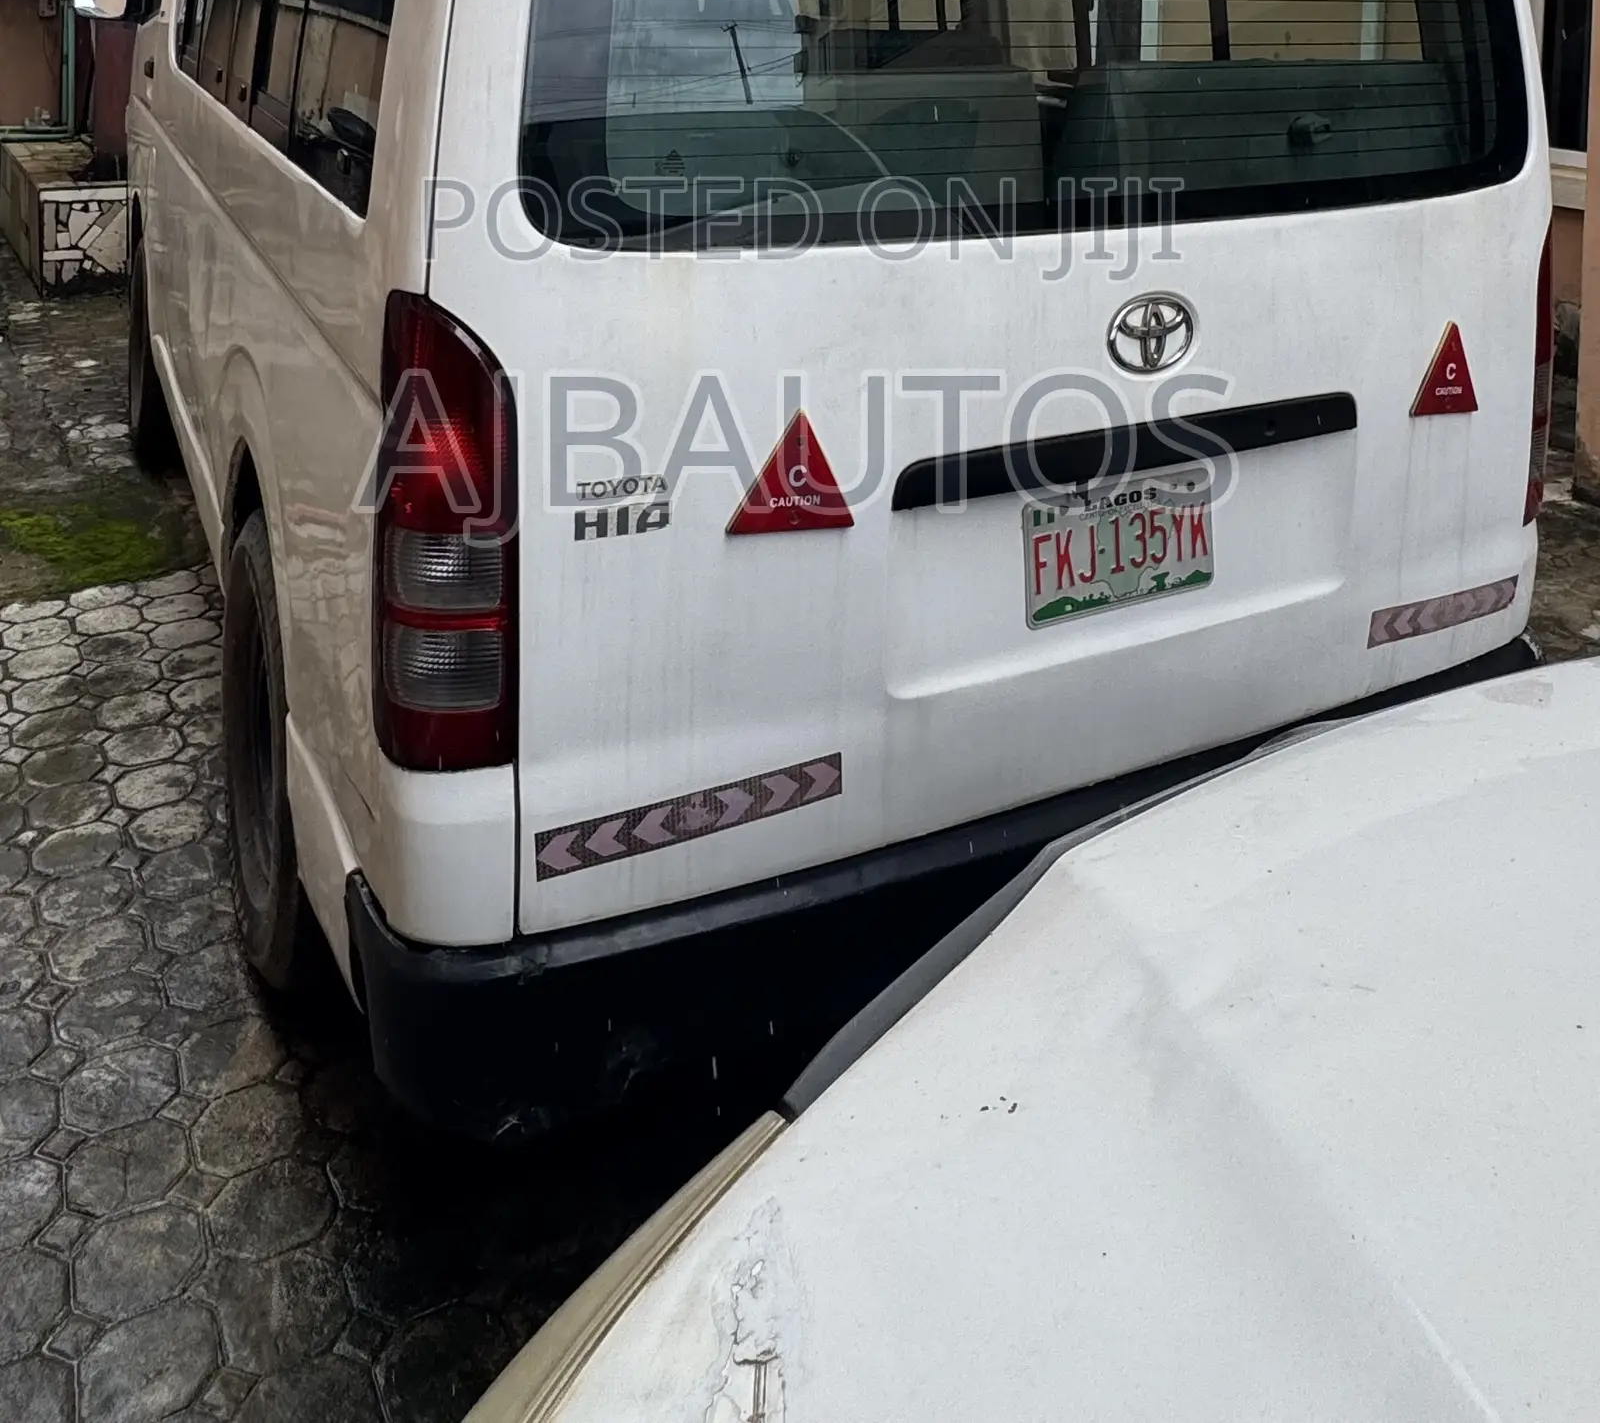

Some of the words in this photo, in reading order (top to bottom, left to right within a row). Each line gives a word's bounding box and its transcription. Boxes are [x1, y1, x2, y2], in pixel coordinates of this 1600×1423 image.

[1446, 363, 1457, 380] C
[1435, 386, 1463, 395] CAUTION
[789, 465, 807, 487] C
[576, 476, 668, 499] TOYOTA
[769, 495, 820, 508] CAUTION
[1084, 487, 1157, 513] LAGOS
